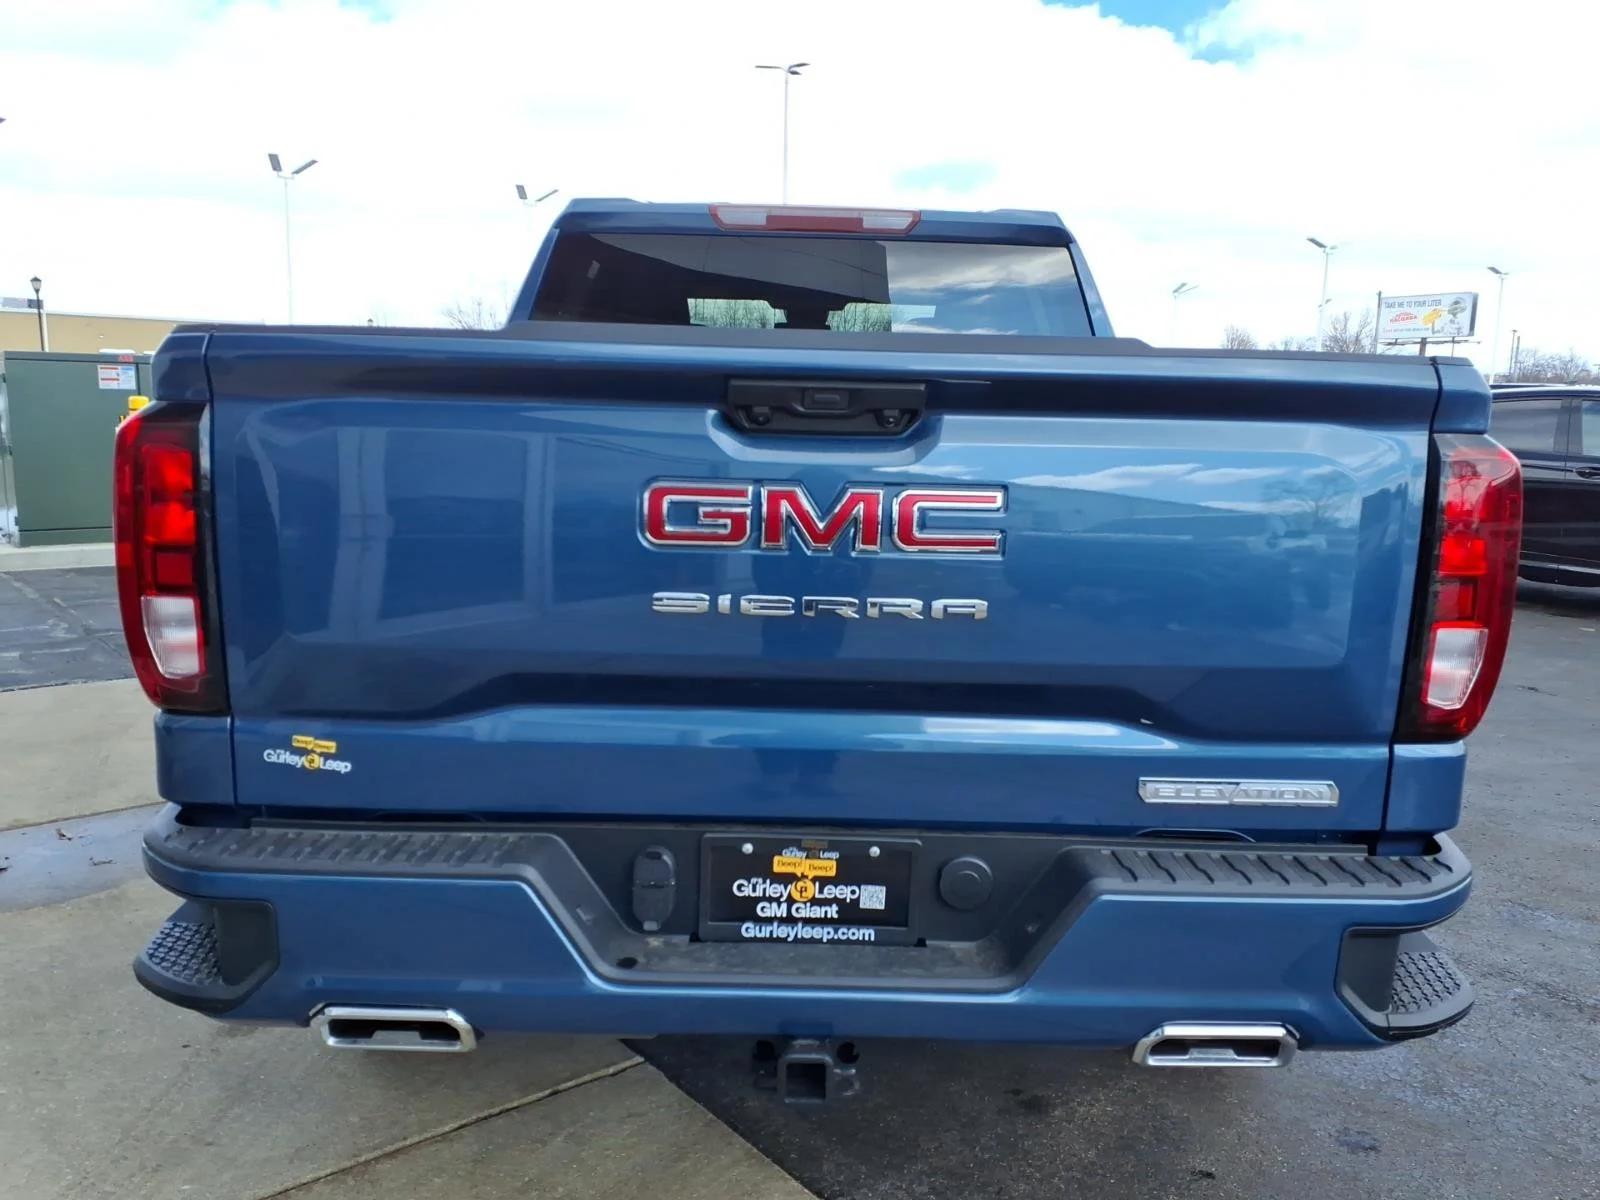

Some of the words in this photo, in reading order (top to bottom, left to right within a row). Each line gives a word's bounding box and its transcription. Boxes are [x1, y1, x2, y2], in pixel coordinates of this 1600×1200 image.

[641, 480, 1004, 554] GMC
[651, 591, 988, 620] SIERRA
[319, 757, 352, 774] Leep
[1153, 784, 1325, 800] ELEVATION
[808, 863, 834, 872] Beep!
[815, 881, 860, 903] Leep
[756, 902, 787, 917] GM
[791, 902, 839, 918] Giant
[741, 921, 876, 942] Gurleyleep.com
